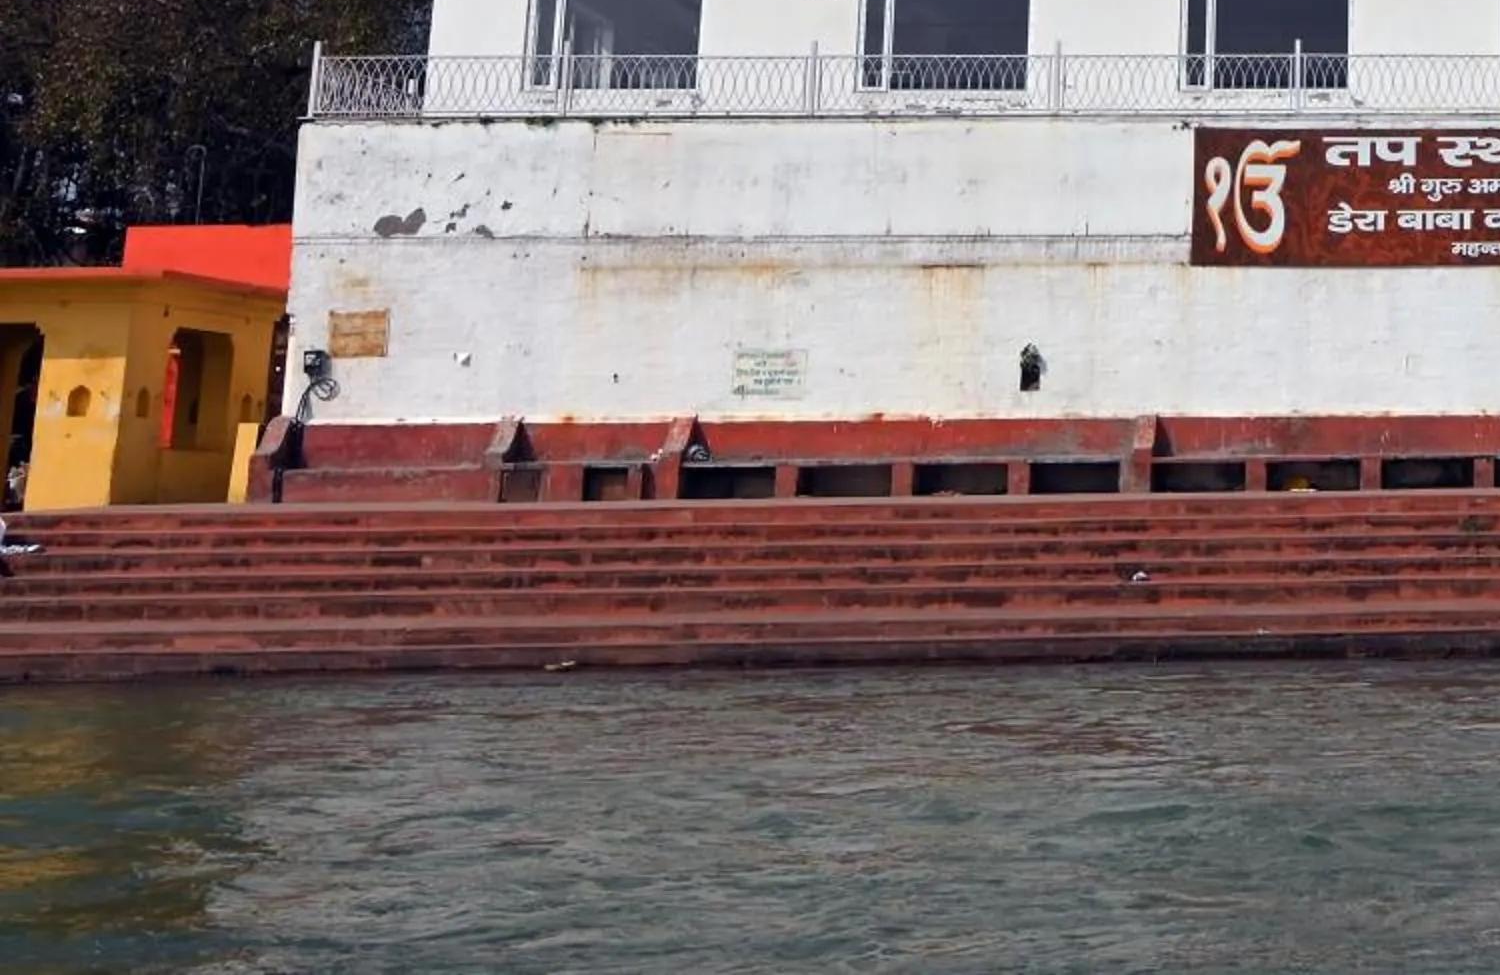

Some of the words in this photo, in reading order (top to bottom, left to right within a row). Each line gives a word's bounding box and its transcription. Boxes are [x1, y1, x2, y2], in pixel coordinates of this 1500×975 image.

[1322, 136, 1422, 167] तप
[1388, 173, 1416, 194] श्री
[1420, 178, 1464, 202] गुरु
[1328, 201, 1388, 233] डेरा
[1397, 209, 1475, 231] बाबा
